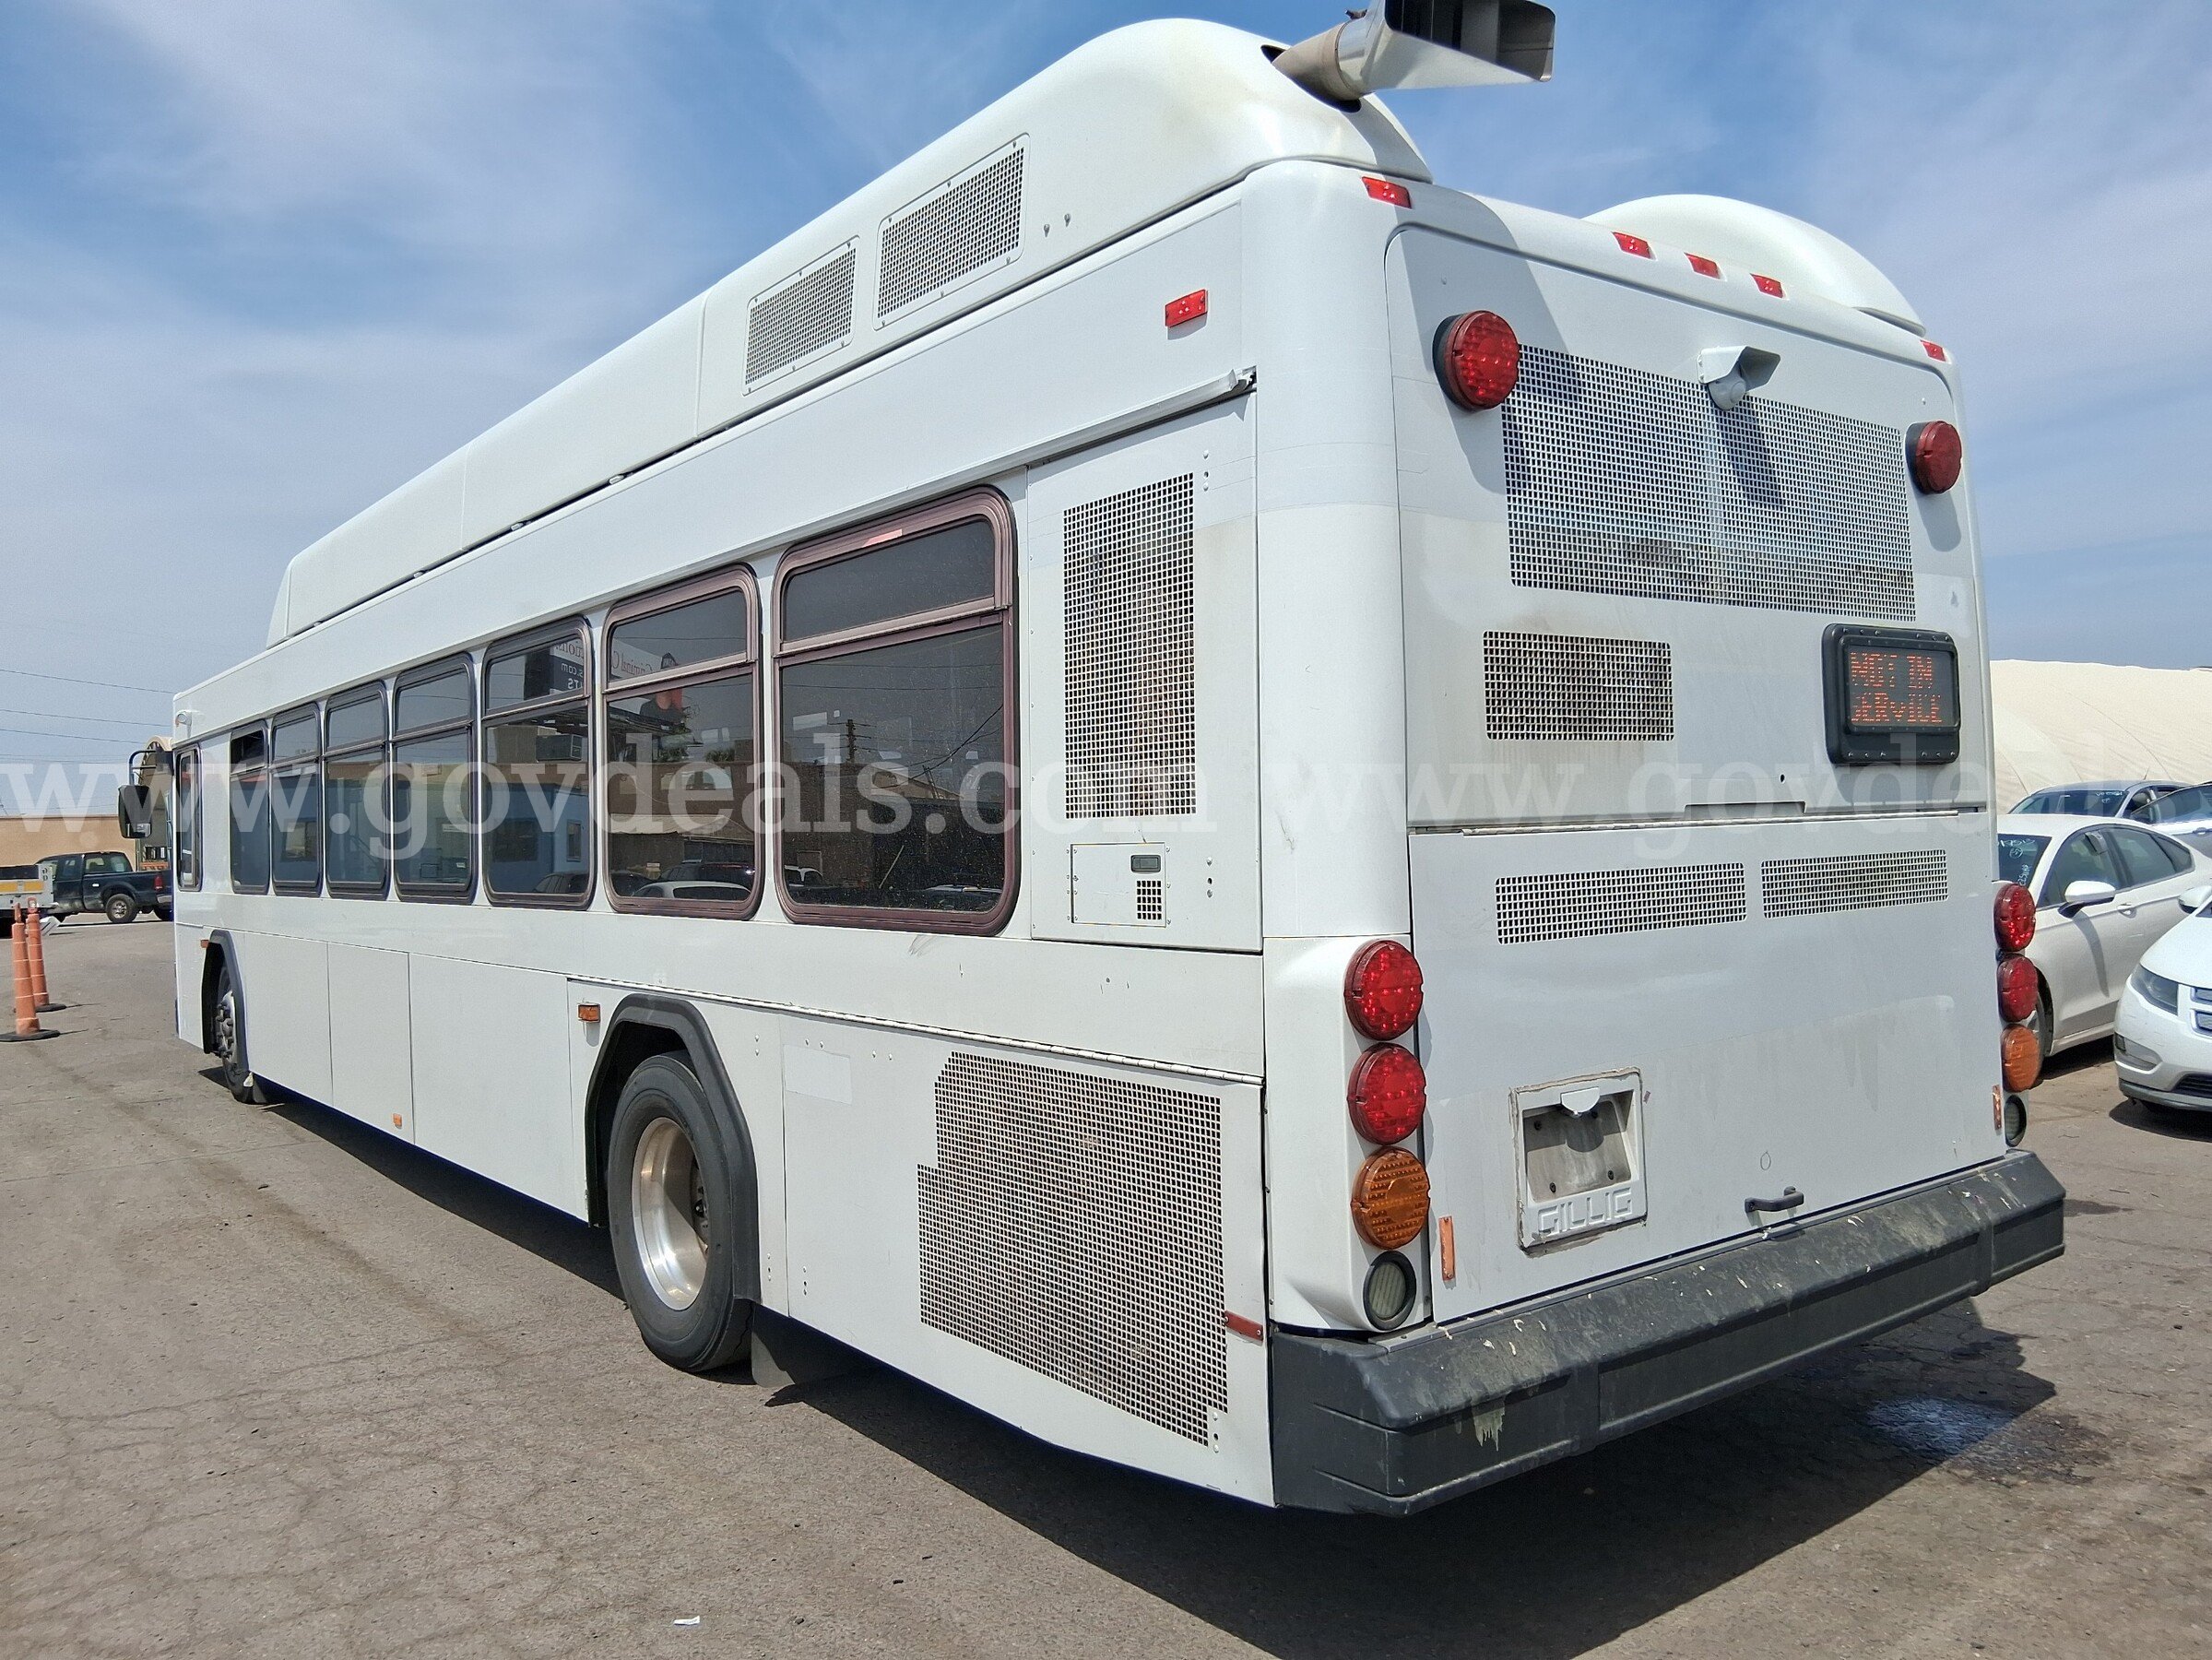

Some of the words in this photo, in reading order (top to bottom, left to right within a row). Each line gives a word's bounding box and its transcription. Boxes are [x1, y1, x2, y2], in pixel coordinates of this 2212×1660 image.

[1851, 651, 1899, 688] NOT
[1906, 655, 1934, 689] IN
[1538, 1187, 1633, 1237] GILLIG
